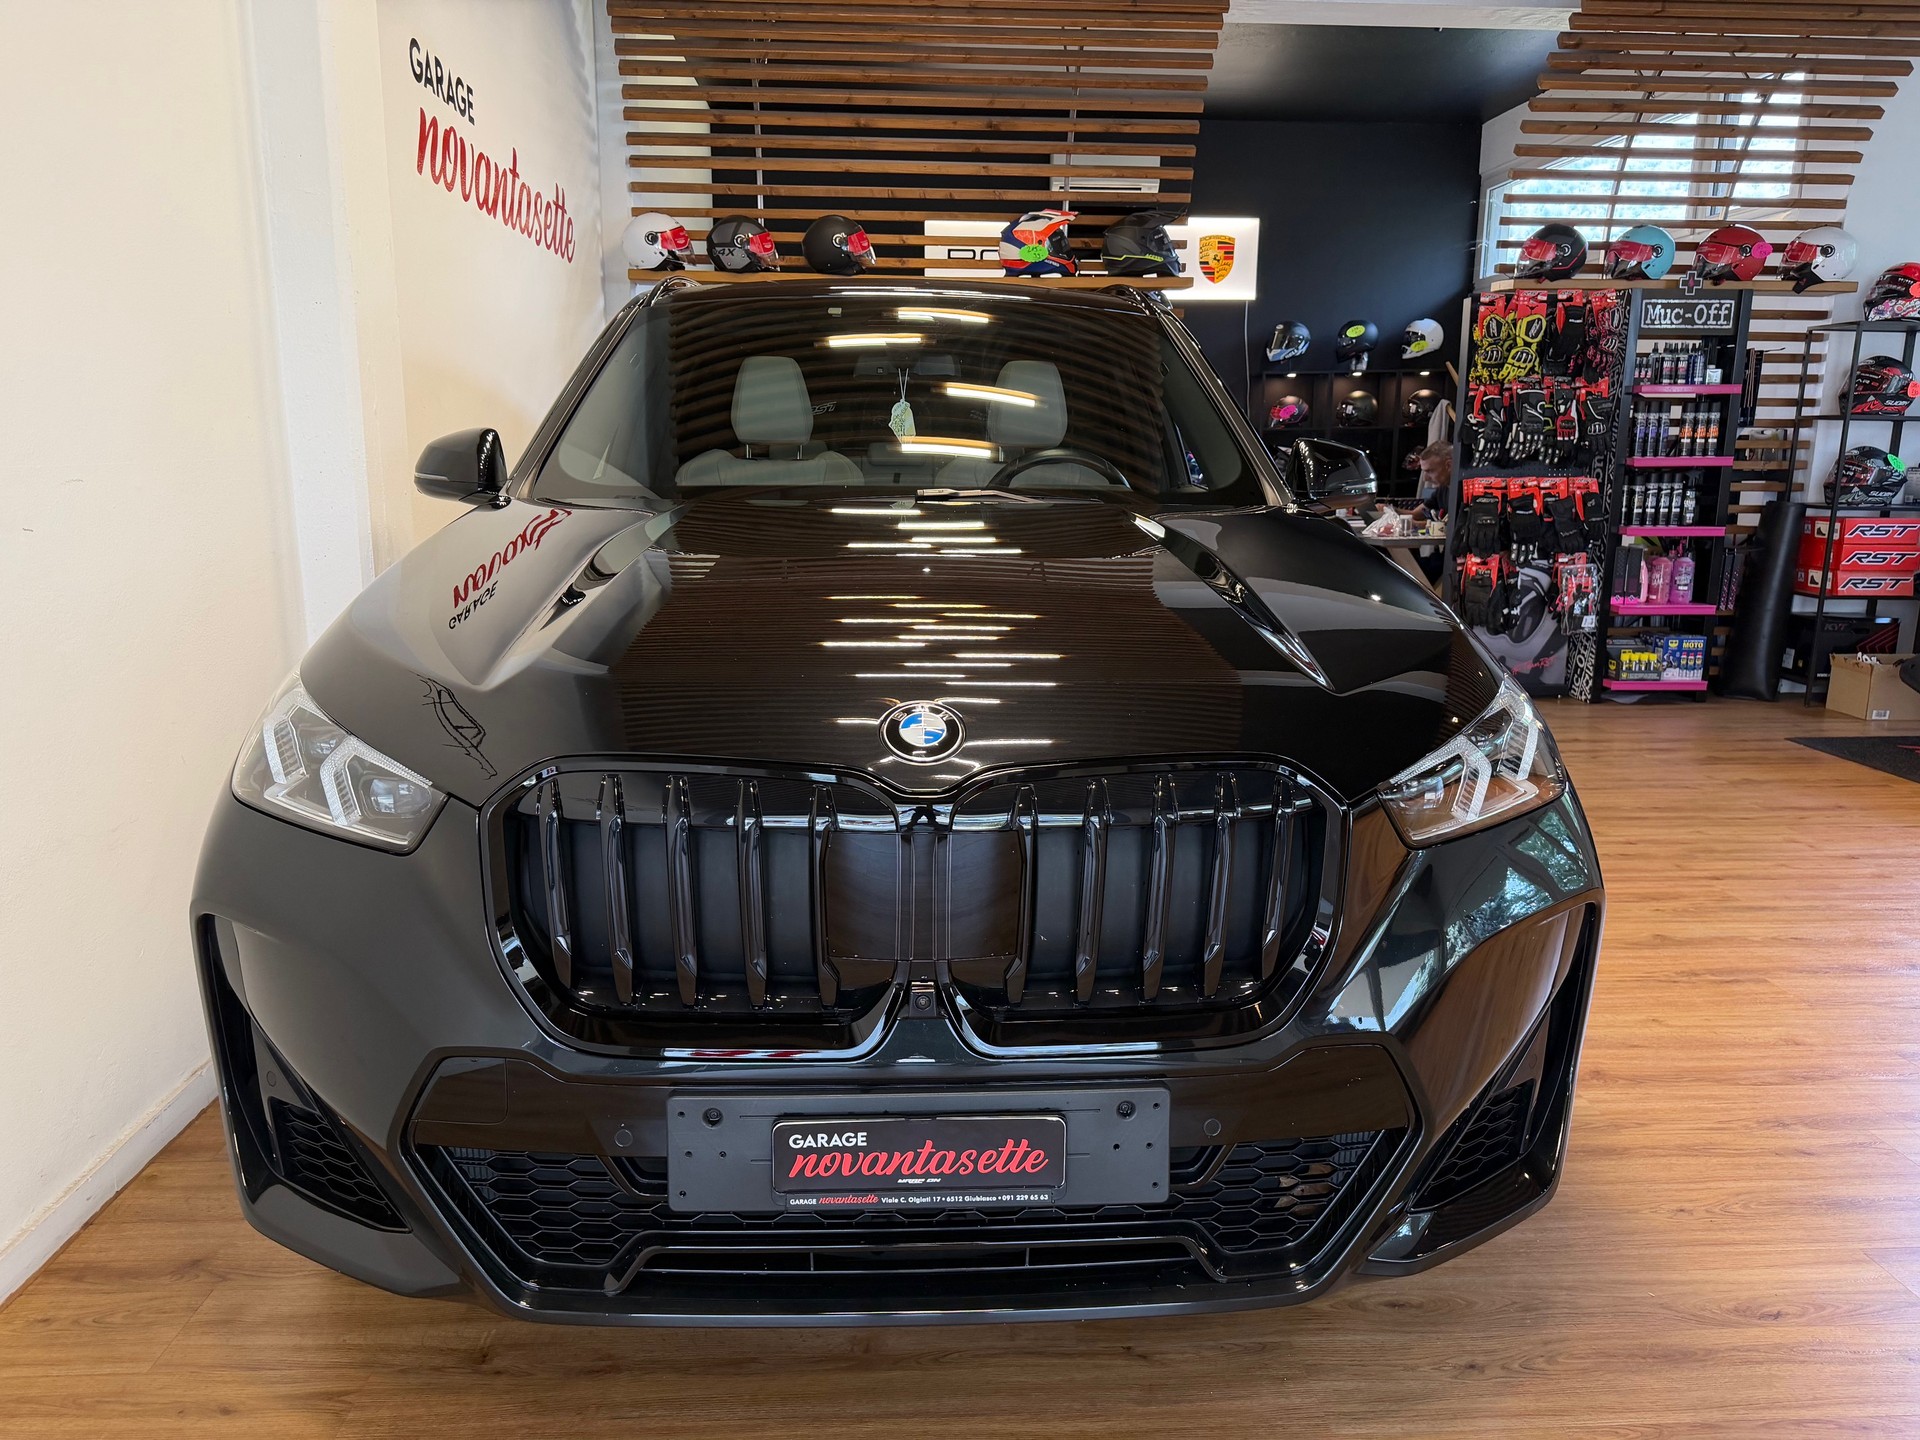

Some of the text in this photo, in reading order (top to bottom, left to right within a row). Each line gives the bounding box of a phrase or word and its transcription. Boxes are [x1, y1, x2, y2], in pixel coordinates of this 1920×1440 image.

[409, 37, 475, 126] GARAGE
[416, 107, 575, 264] novantasette
[1645, 303, 1731, 325] Muc-Off
[1845, 523, 1920, 538] RST
[1841, 550, 1919, 565] RST
[1838, 576, 1914, 591] RST
[788, 1132, 868, 1149] GARAGE
[788, 1137, 1049, 1178] novantasette
[818, 1194, 880, 1205] novantasette
[881, 1196, 899, 1204] Viale
